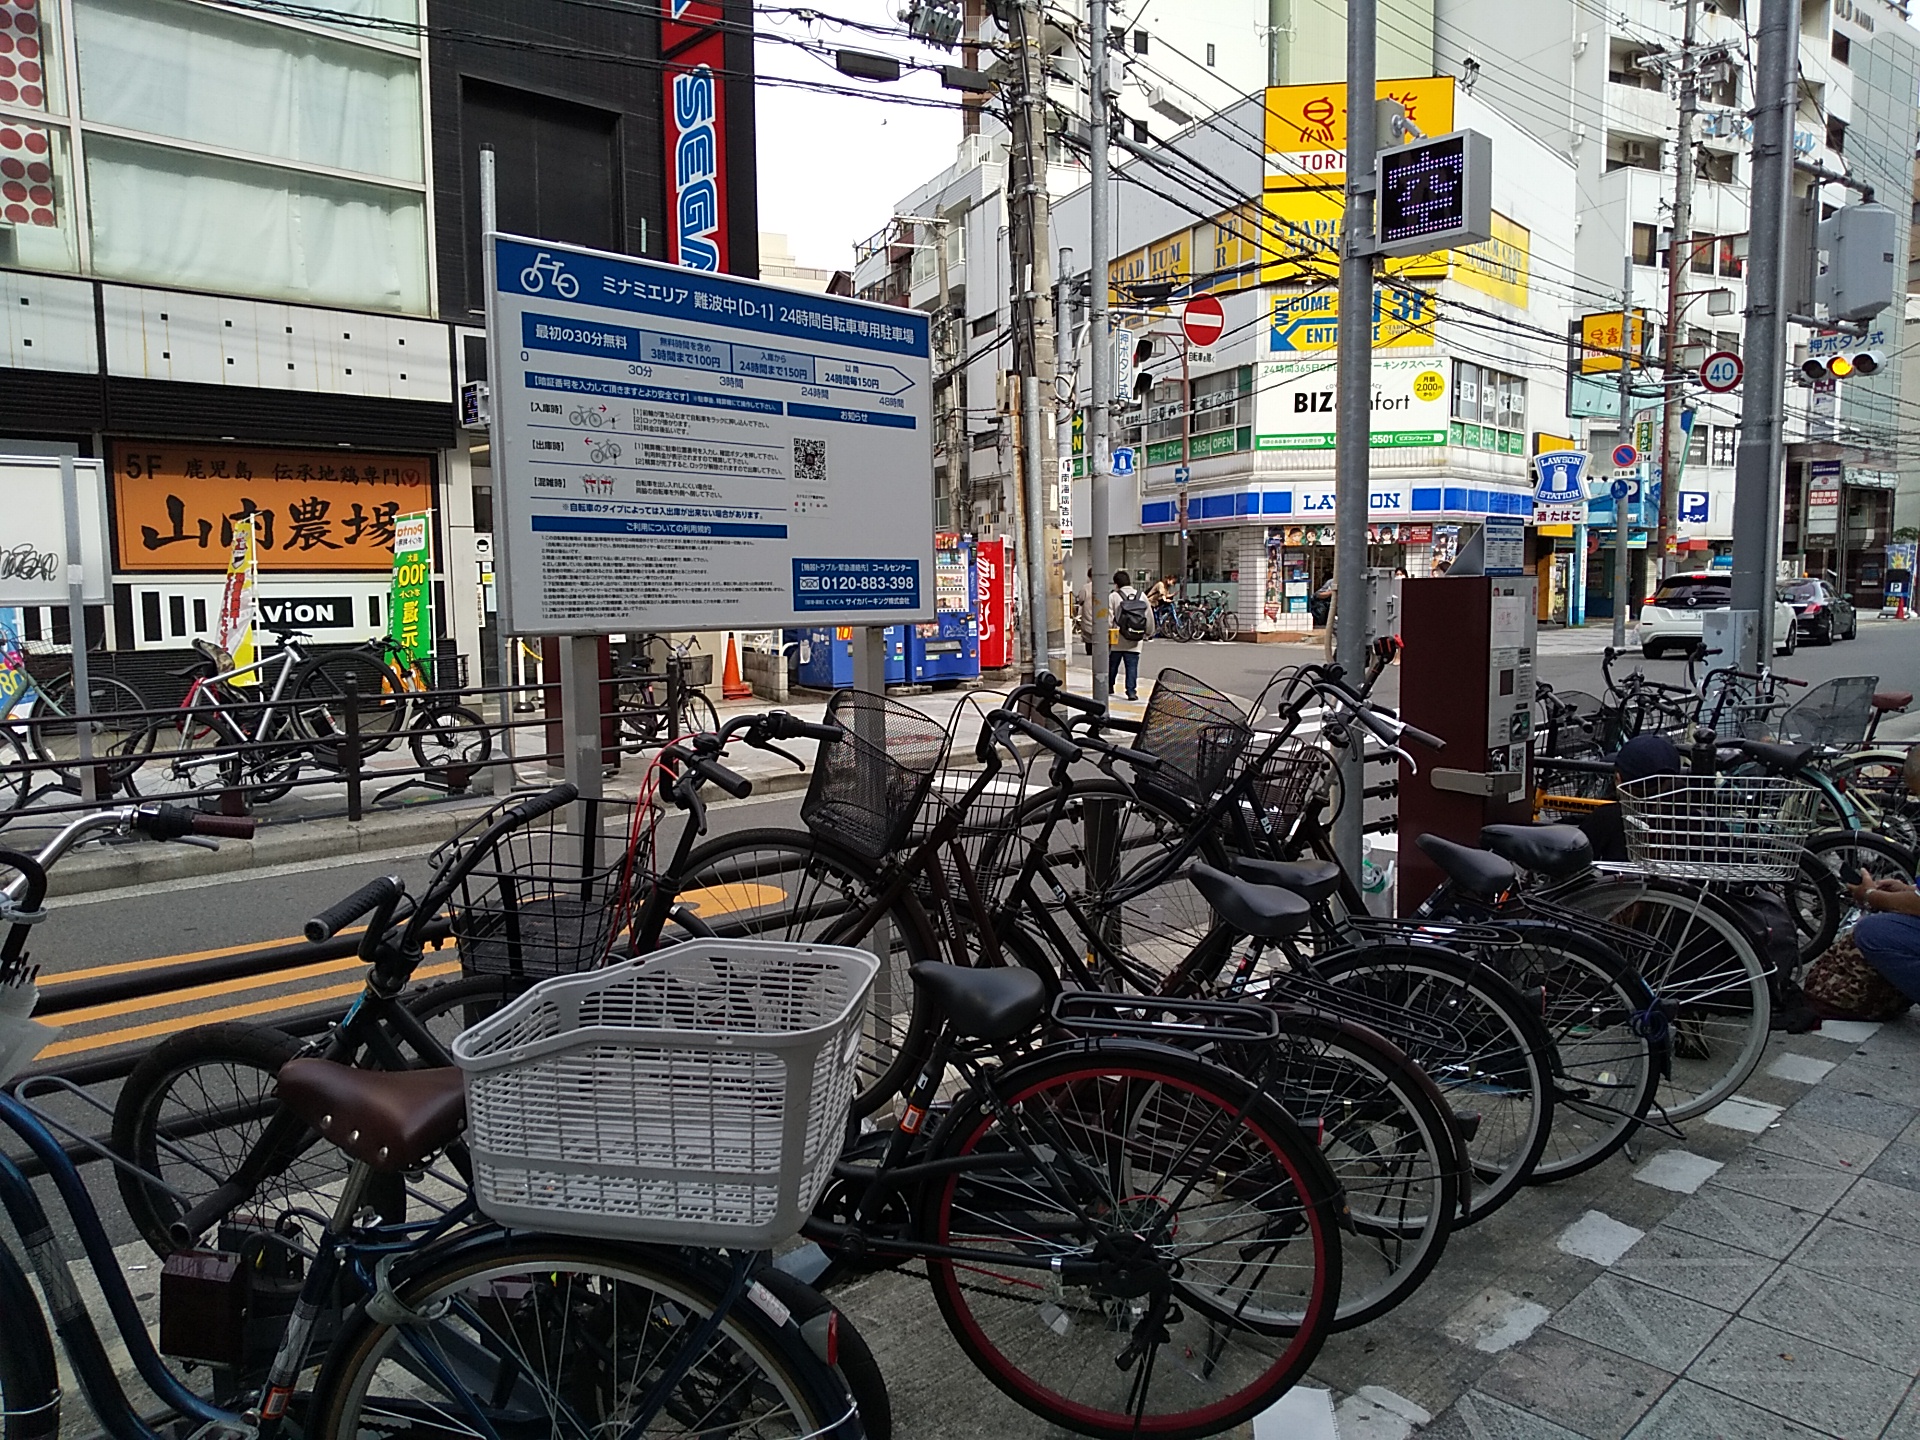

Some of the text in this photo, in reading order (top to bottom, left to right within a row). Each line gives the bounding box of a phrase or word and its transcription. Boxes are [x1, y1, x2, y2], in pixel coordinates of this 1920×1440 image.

[603, 275, 689, 304] ミナミエリア
[780, 307, 914, 345] 24時間自転車専用駐車場
[535, 324, 628, 350] 最初の30分無料
[520, 351, 530, 362] 0
[651, 349, 720, 368] 3時間まで100円
[761, 351, 787, 363] 入庫から
[628, 364, 653, 378] 30分
[740, 361, 807, 380] 24時間まで150円
[1709, 362, 1735, 382] 40
[719, 376, 744, 390] 3時間
[801, 386, 829, 400] 24時間
[879, 396, 905, 409] 48時間
[840, 410, 869, 423] お知らせ
[1541, 456, 1581, 467] LAWSON
[125, 454, 400, 487] 5F 鹿児島 伝承地鶏専門
[1303, 493, 1400, 510] LAON
[1539, 489, 1580, 500] STATION
[1682, 493, 1706, 513] P
[141, 493, 399, 553] 山内農場
[872, 563, 911, 573] コールセンター
[821, 576, 914, 590] 0120-883-398
